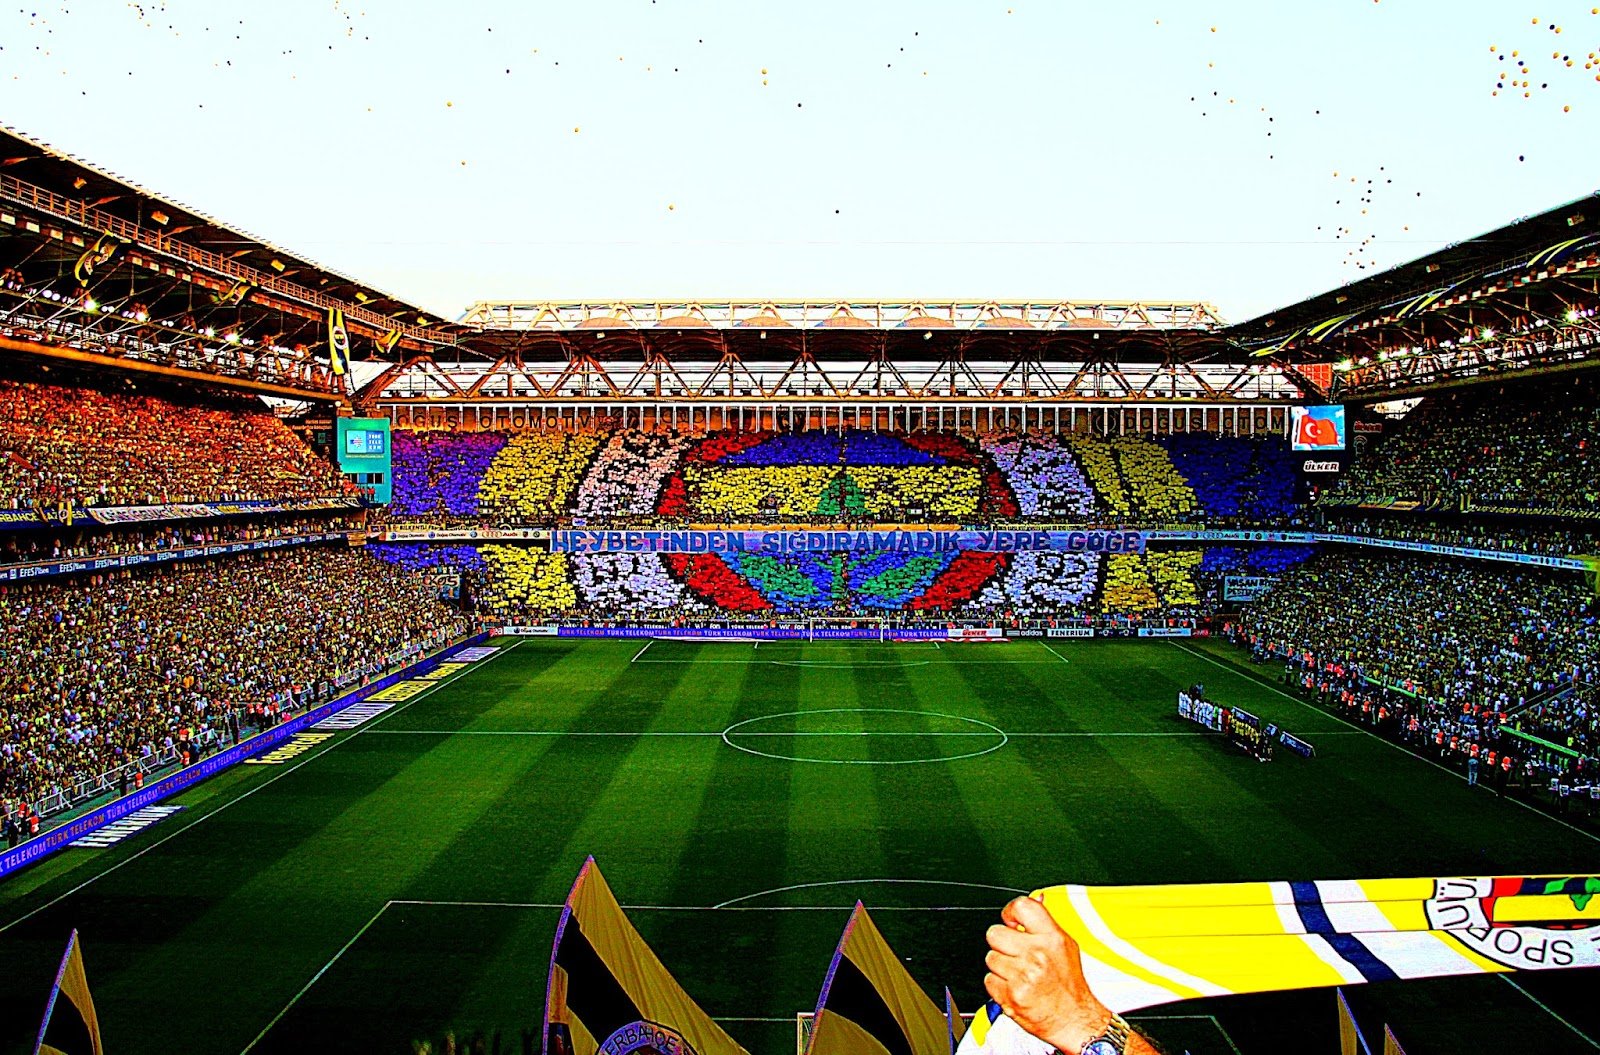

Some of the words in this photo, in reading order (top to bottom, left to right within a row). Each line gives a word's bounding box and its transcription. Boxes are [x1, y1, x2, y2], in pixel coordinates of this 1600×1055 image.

[1304, 460, 1339, 471] ÜLKER
[978, 530, 1050, 552] YERE
[174, 767, 200, 788] TELEKOM
[106, 802, 127, 820] TÜRK
[126, 788, 158, 811] TELEKOM
[69, 814, 105, 837] TELEKOM
[4, 840, 46, 870] TELEKOM
